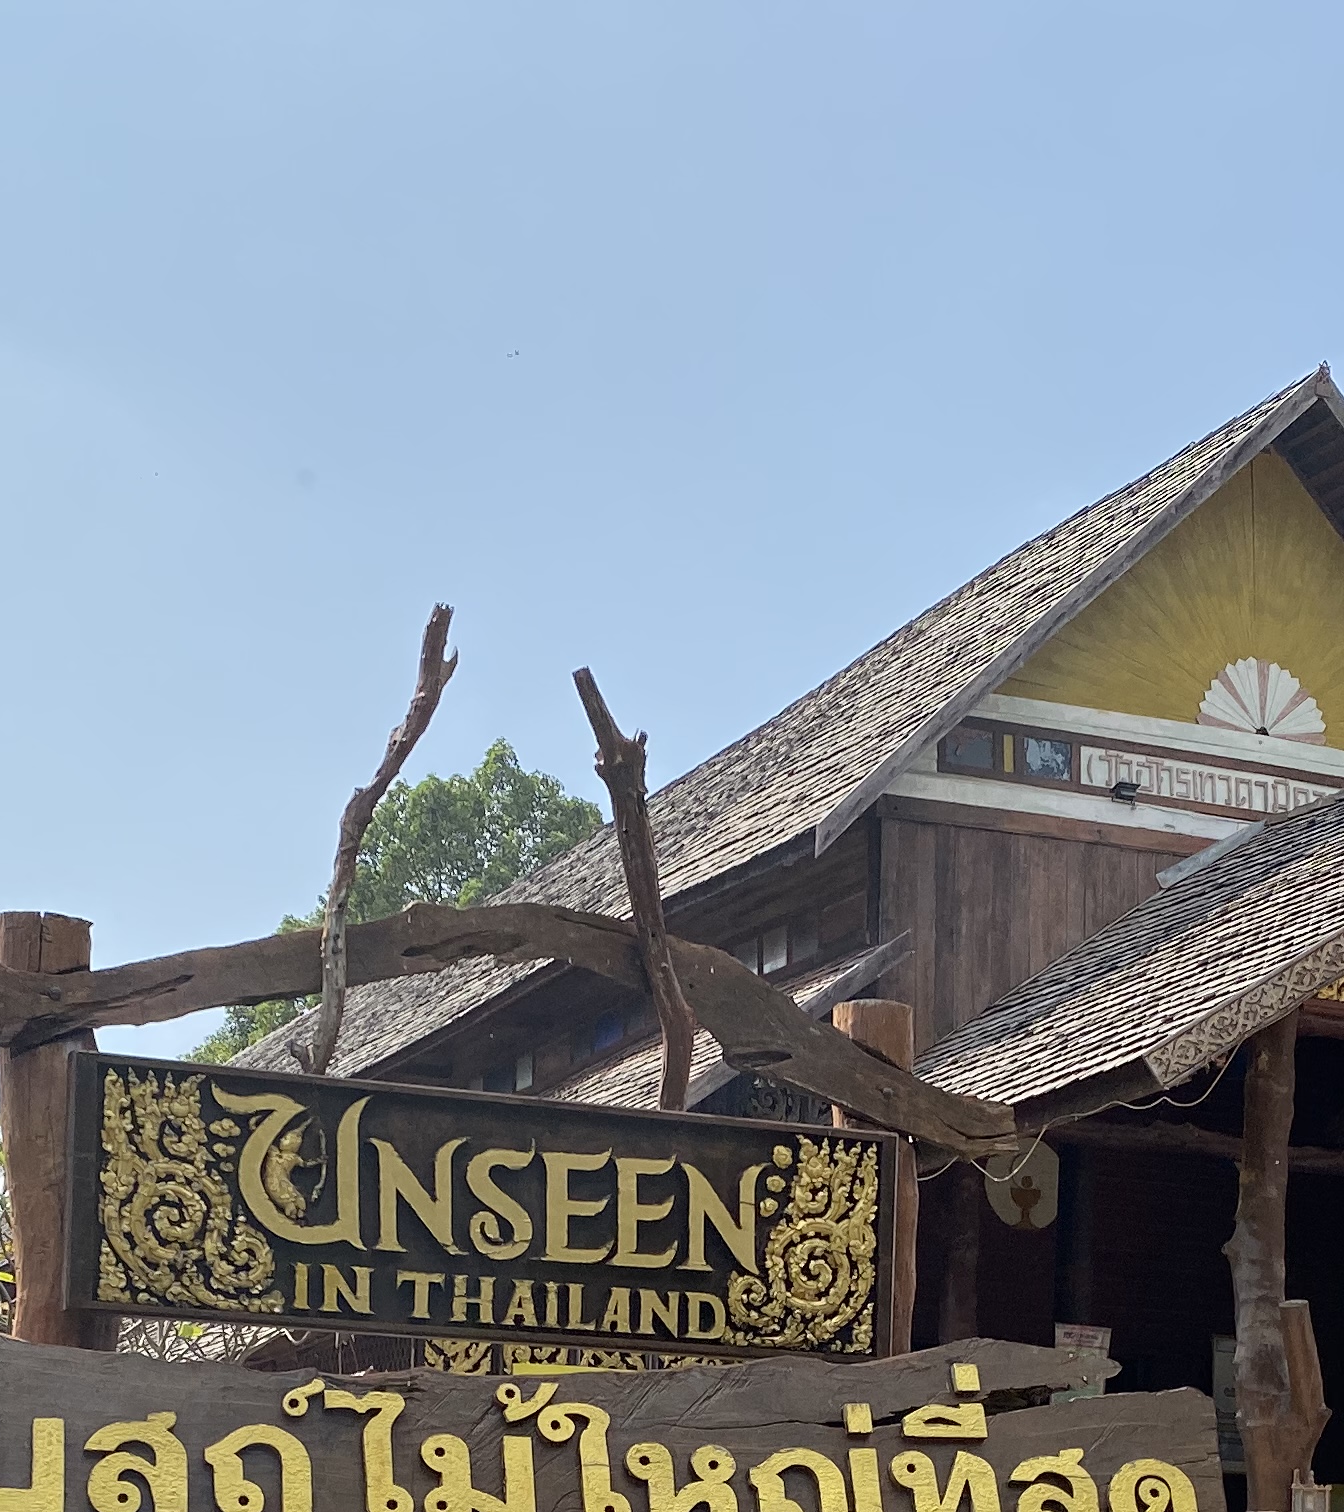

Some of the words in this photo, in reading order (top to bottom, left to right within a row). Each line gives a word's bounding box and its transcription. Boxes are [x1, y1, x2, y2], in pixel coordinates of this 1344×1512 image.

[211, 1082, 777, 1278] UNSEEN
[294, 1262, 376, 1316] IN
[397, 1270, 728, 1341] THAILAND
